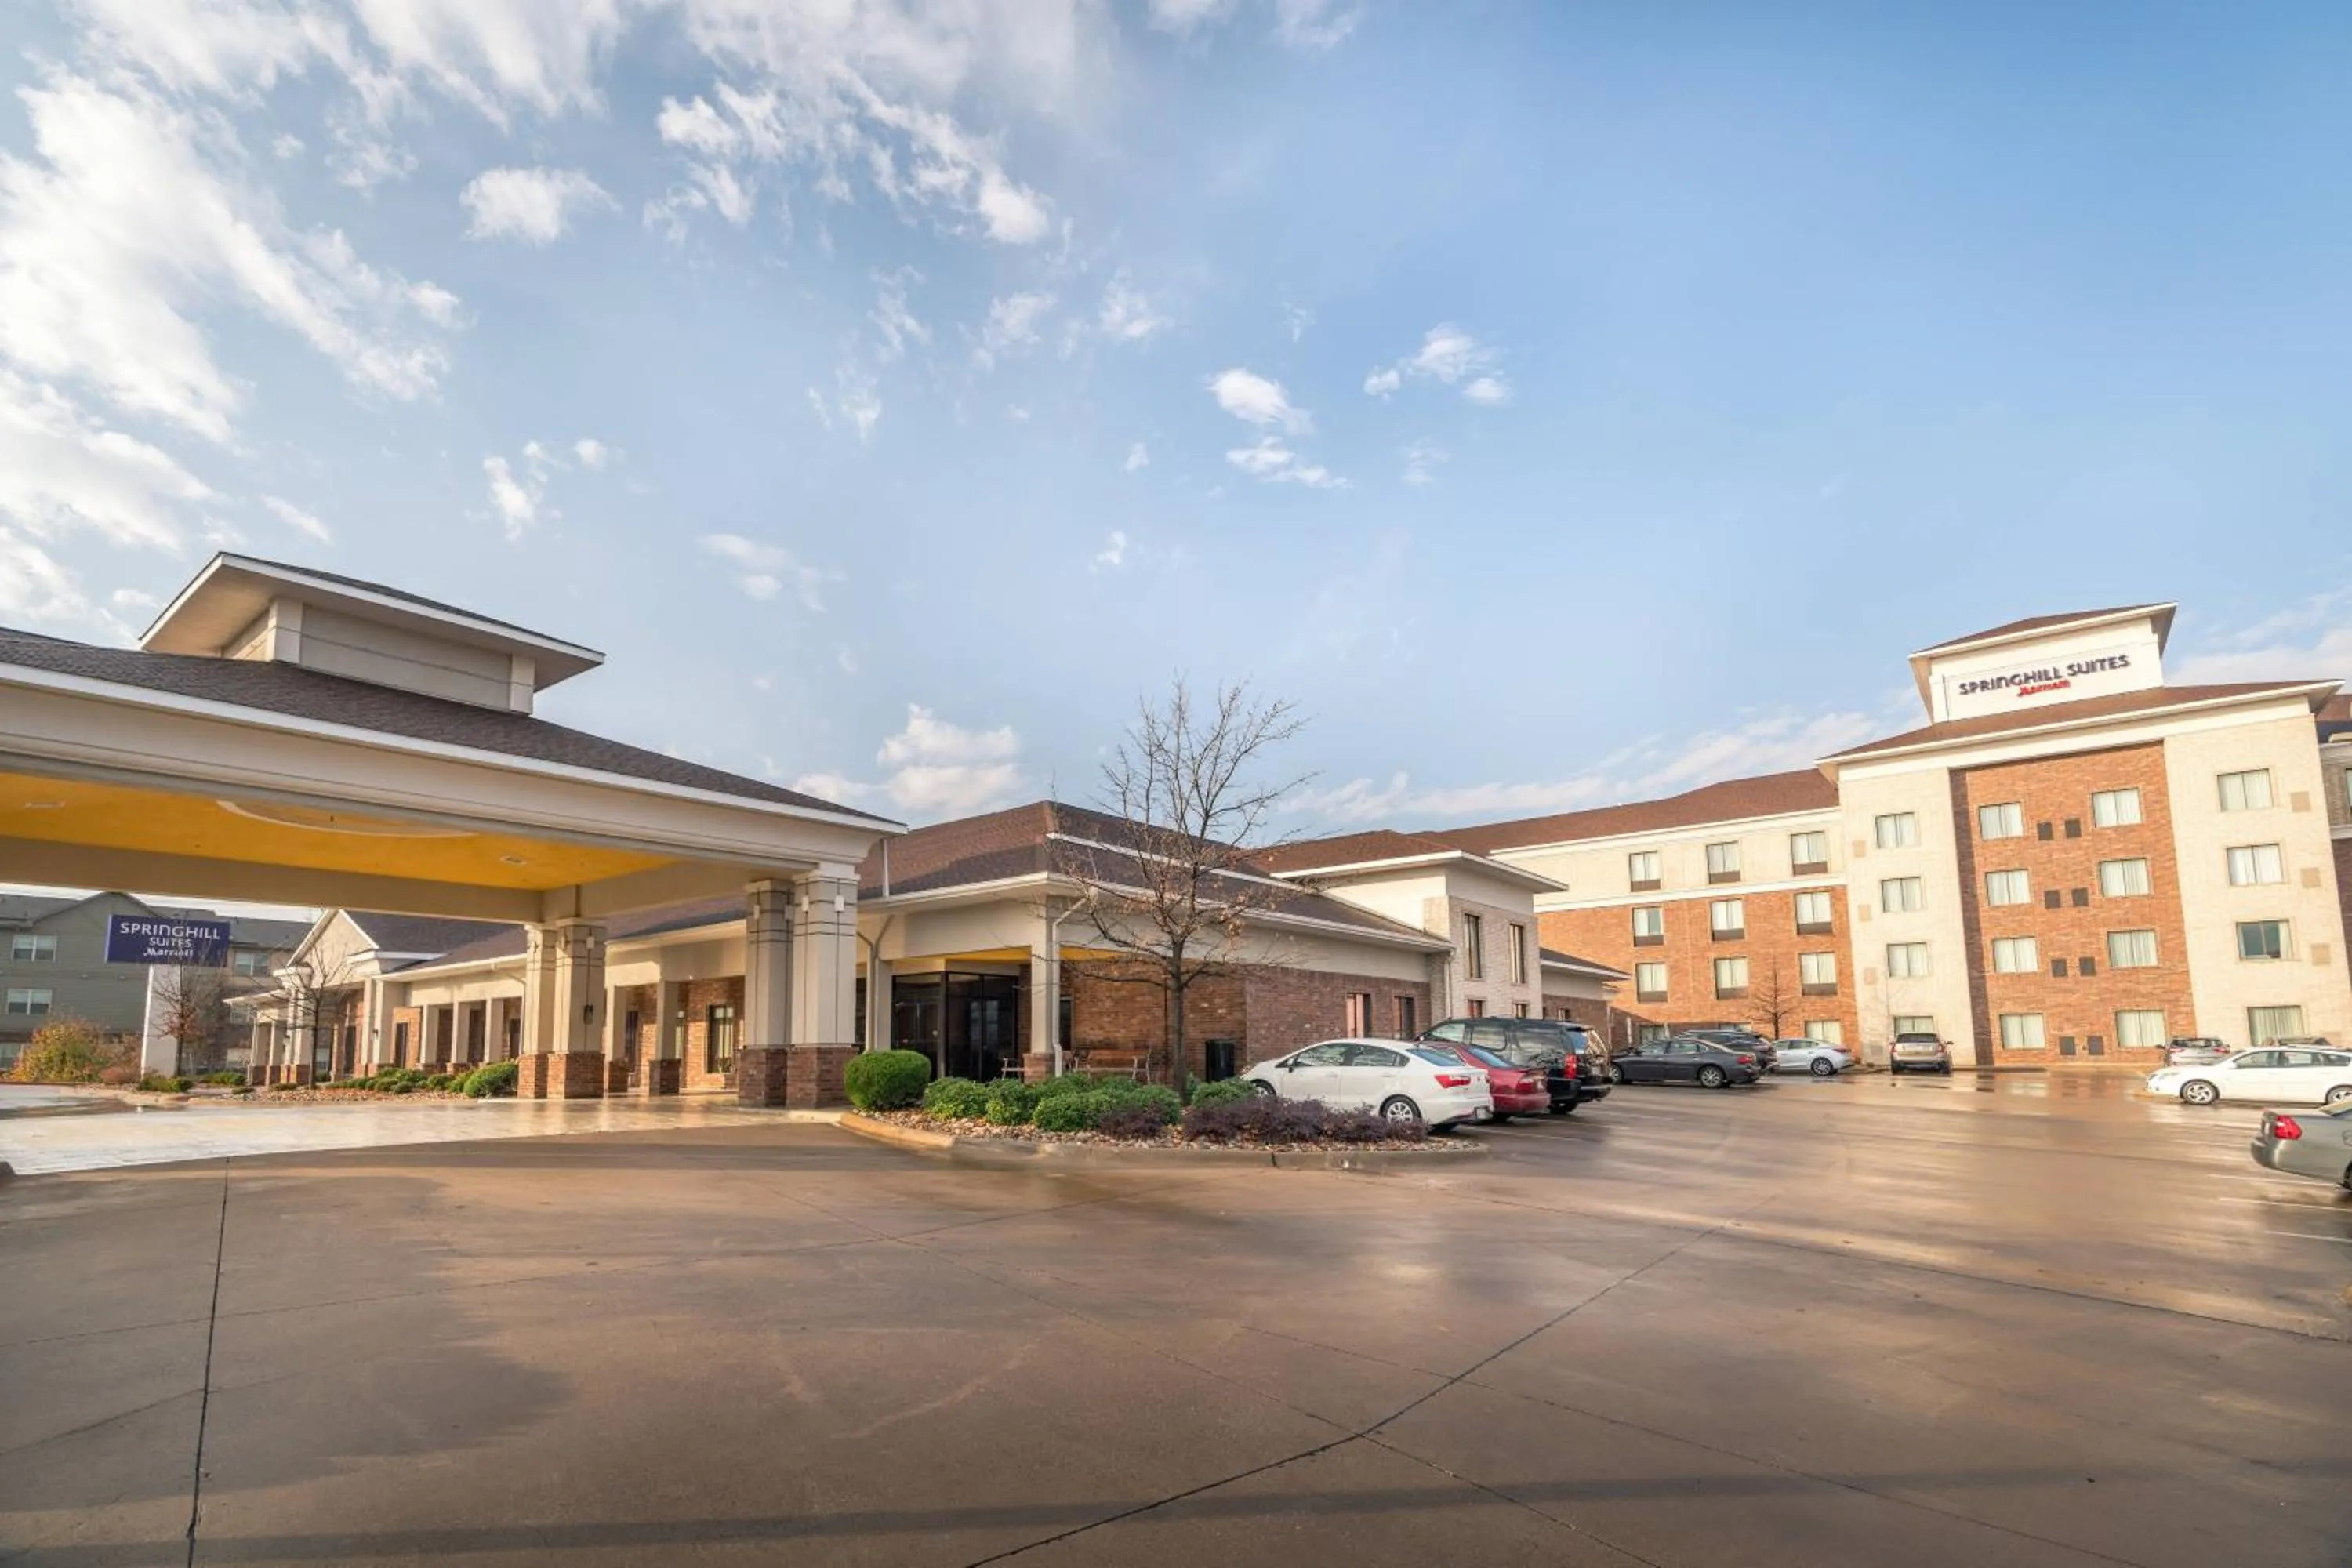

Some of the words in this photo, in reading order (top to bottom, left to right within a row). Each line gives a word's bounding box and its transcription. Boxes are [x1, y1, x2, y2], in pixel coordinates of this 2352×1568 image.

[1959, 666, 2062, 695] SPRINGHILL
[2067, 654, 2130, 677] SUITES
[120, 922, 220, 939] SPRINGHILL
[149, 937, 192, 948] SUITES
